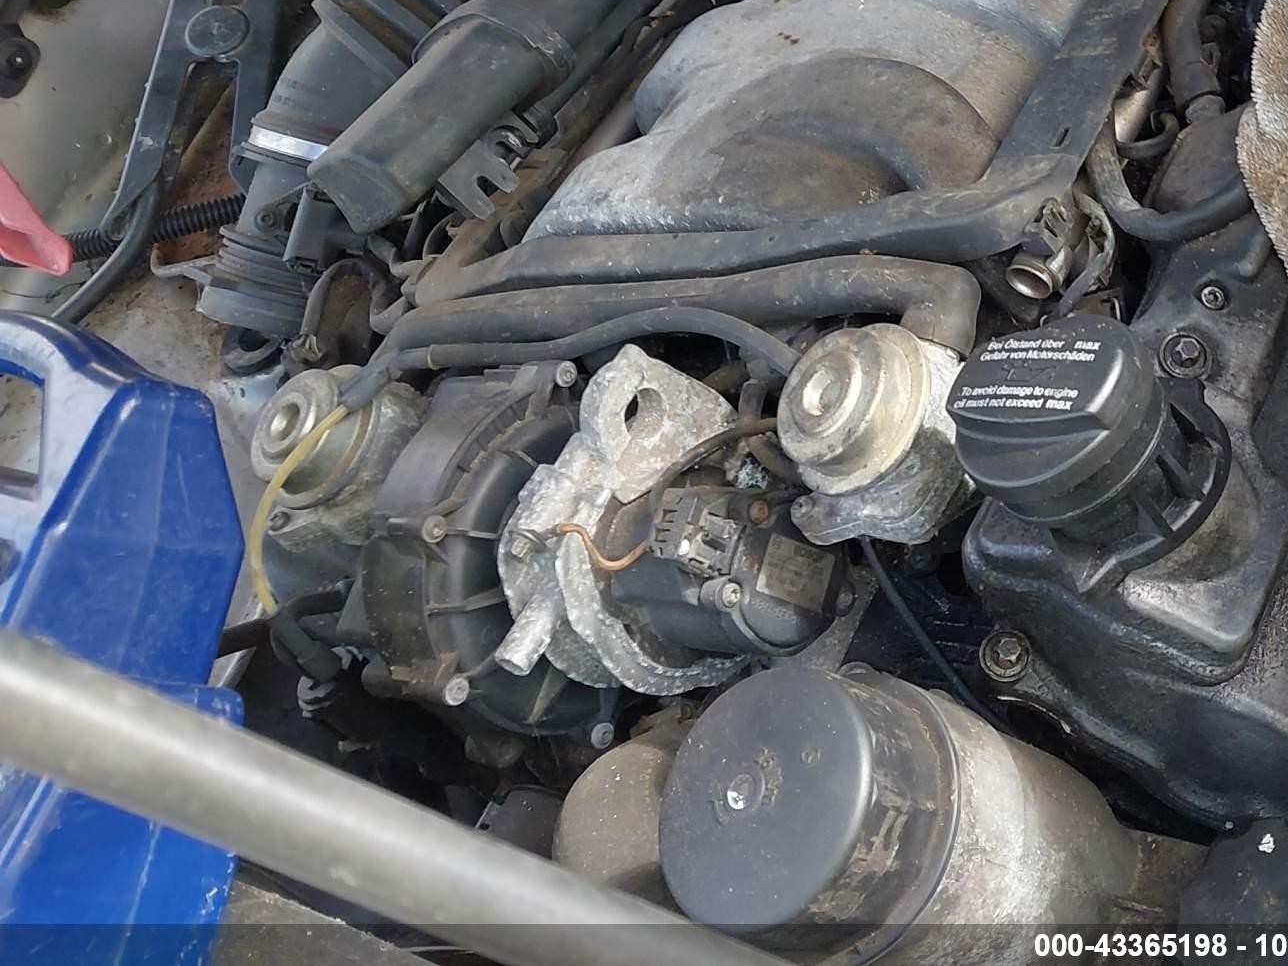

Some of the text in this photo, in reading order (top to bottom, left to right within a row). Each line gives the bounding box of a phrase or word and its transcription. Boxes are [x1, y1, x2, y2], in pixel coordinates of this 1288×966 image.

[988, 338, 1101, 351] Bei Ölstand über max
[980, 350, 1095, 362] Gefahr von Motorschäden
[962, 386, 1079, 399] To avoid damage to engine
[954, 398, 1073, 410] oil must not exceed max
